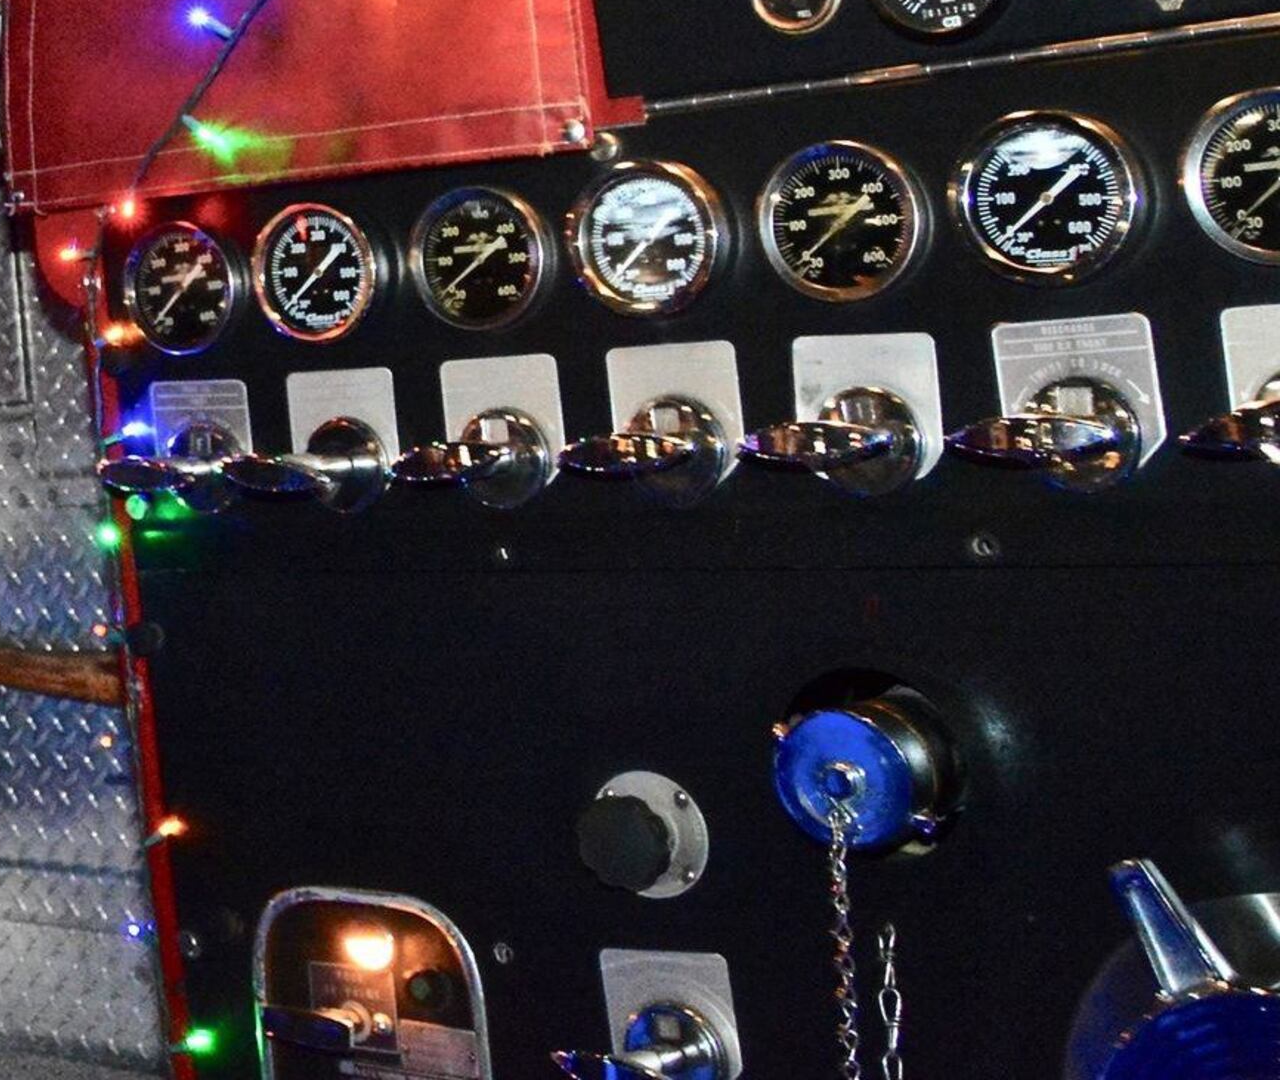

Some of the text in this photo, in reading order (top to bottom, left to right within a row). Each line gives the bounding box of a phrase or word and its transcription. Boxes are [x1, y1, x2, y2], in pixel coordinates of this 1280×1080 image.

[1226, 139, 1251, 152] 200
[828, 168, 850, 180] 300
[861, 182, 883, 194] 400
[1220, 176, 1242, 188] 100
[794, 187, 815, 199] 200
[995, 192, 1016, 205] 100
[1078, 193, 1102, 206] 500
[789, 220, 806, 231] 100
[1247, 217, 1263, 228] 30
[809, 257, 824, 269] 30
[863, 250, 886, 264] 600
